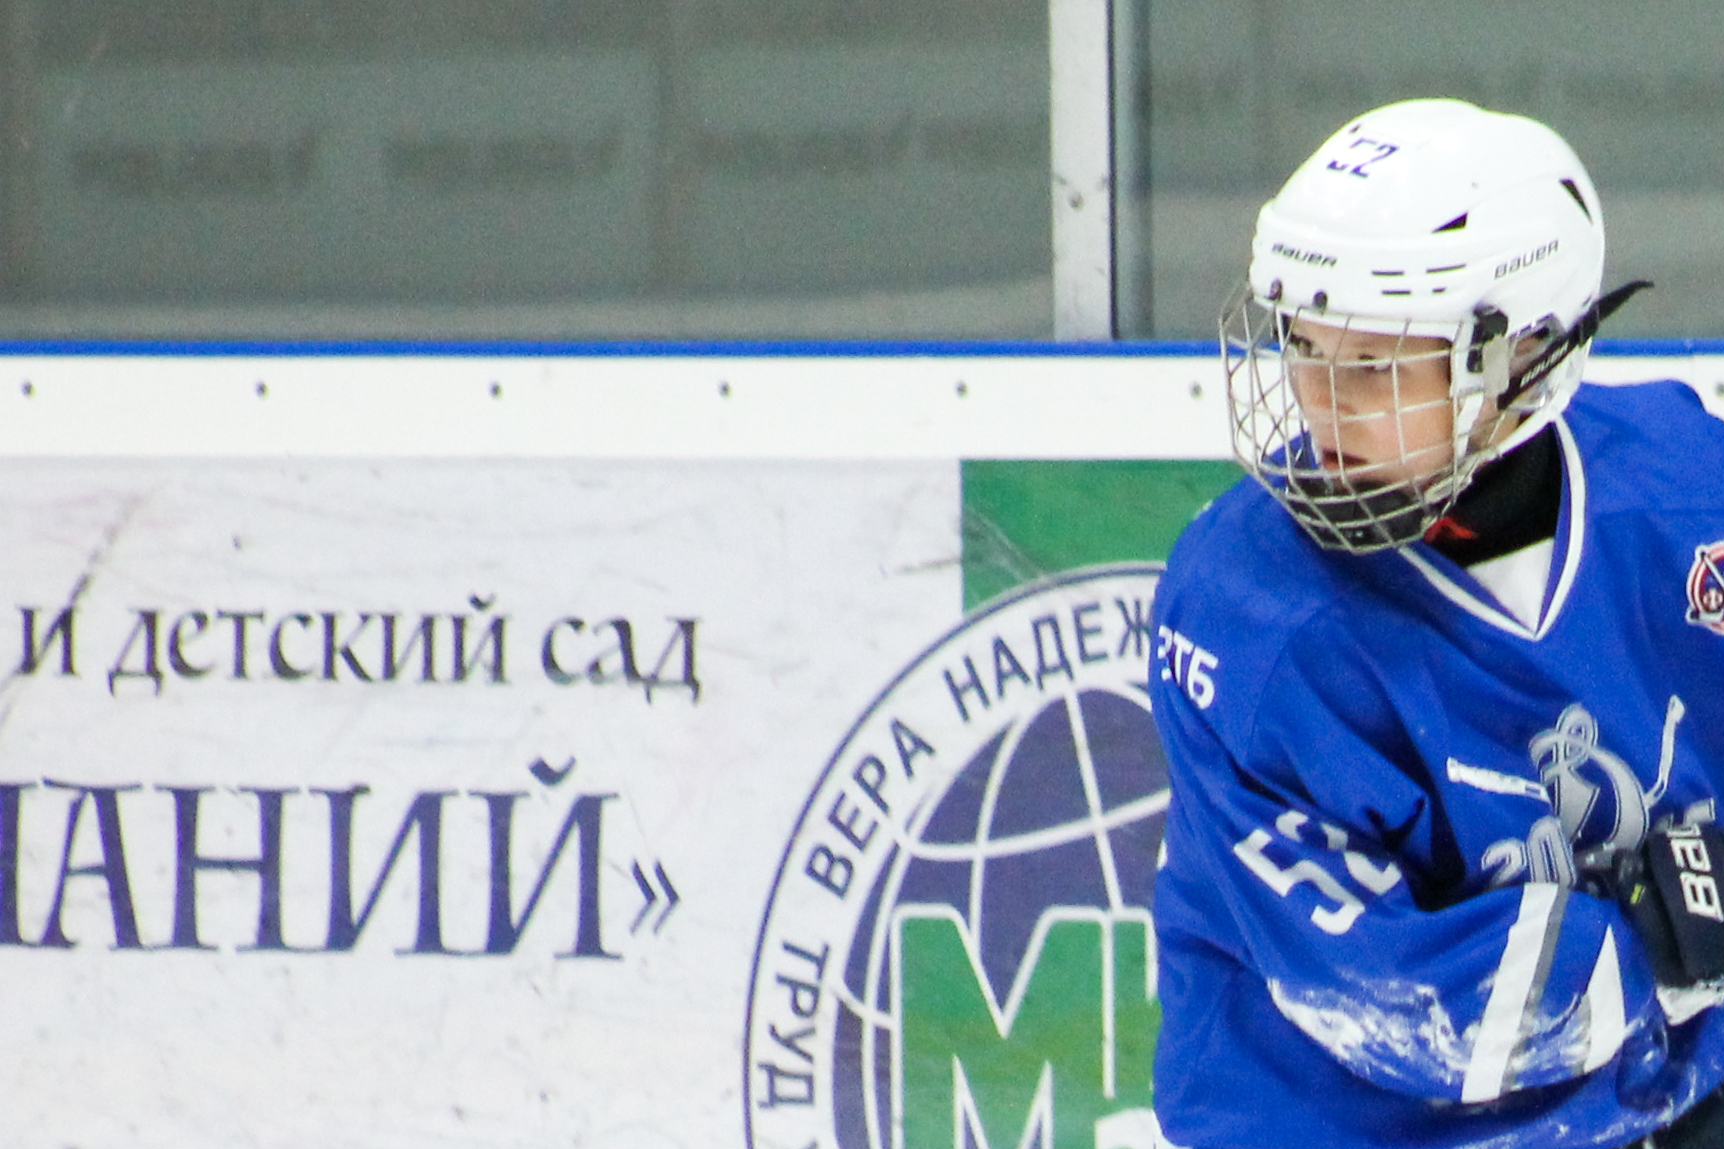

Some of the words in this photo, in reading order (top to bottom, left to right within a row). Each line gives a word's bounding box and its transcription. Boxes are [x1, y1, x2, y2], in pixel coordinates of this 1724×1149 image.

[15, 606, 80, 678] и
[107, 592, 513, 698] детский
[540, 615, 701, 706] сад
[757, 940, 832, 1111] ТРУД
[803, 716, 935, 900] ВЕРА
